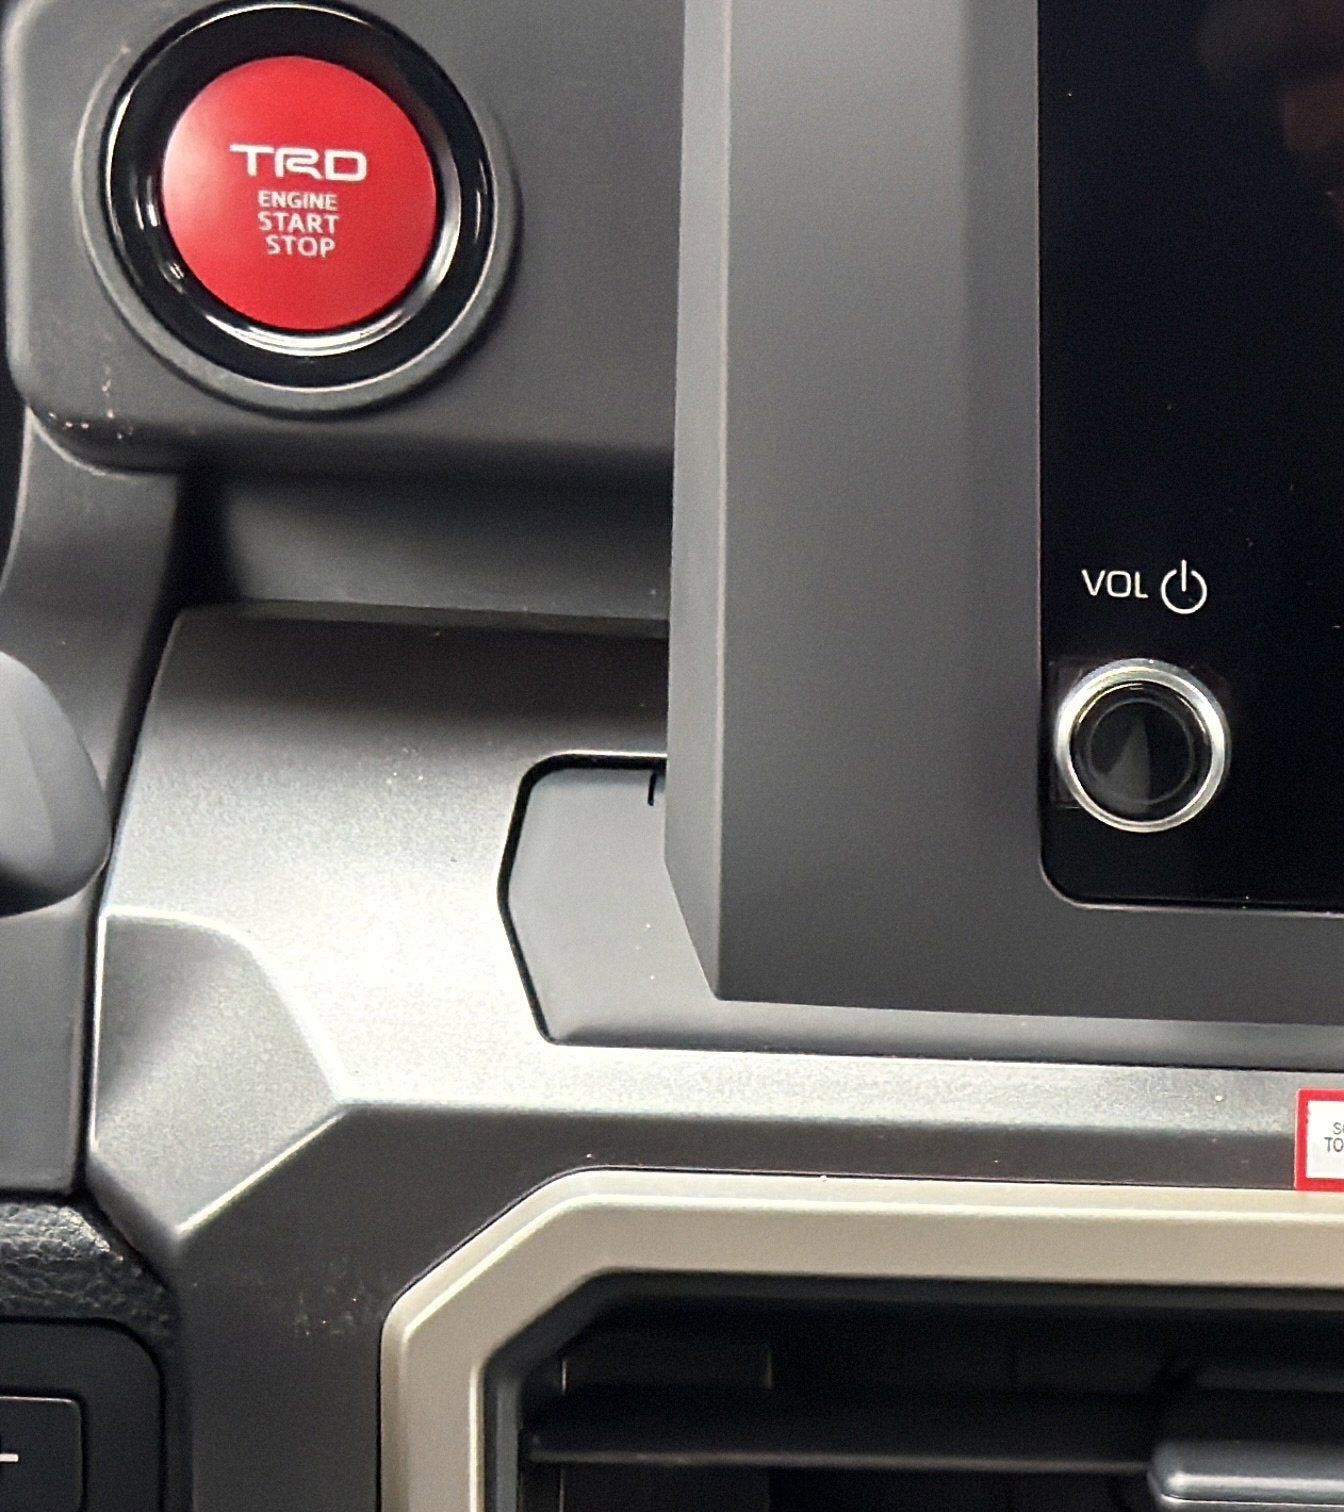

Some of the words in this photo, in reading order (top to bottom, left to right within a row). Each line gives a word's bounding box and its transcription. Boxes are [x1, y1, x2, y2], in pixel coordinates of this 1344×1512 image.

[229, 143, 367, 182] TRD
[257, 190, 338, 212] ENGINE
[257, 212, 340, 234] START
[265, 235, 336, 257] STOP
[1081, 569, 1148, 598] VOL
[1324, 1137, 1344, 1151] TO
